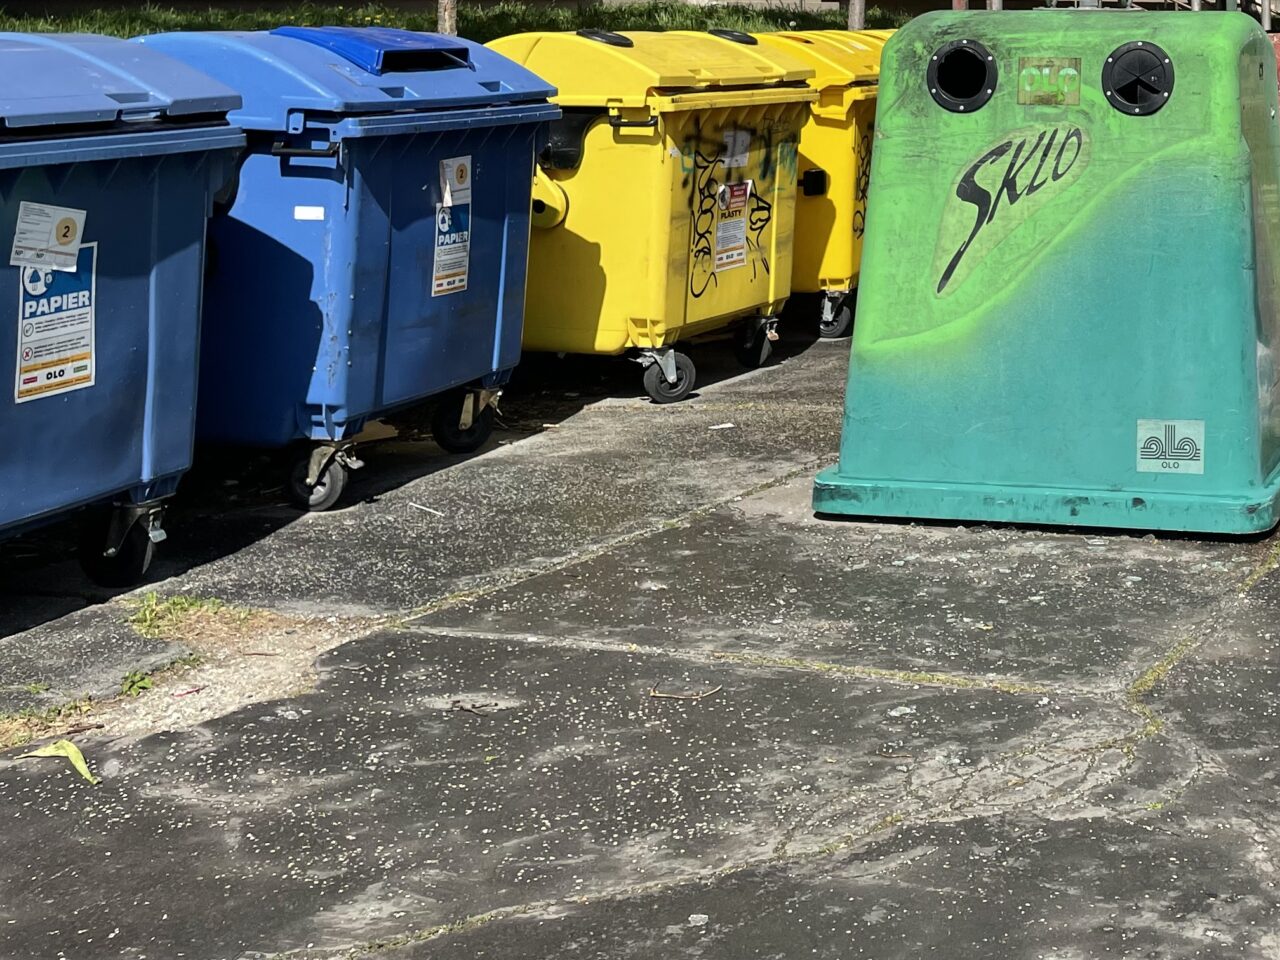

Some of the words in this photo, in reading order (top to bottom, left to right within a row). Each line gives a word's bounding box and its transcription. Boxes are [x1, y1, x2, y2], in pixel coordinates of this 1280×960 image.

[1019, 67, 1080, 92] OLO
[937, 127, 1083, 294] SKLO
[62, 225, 71, 238] 2
[438, 231, 469, 246] PAPIER
[24, 290, 90, 318] PAPIER
[45, 368, 65, 381] OLO
[1161, 461, 1180, 469] OLO
